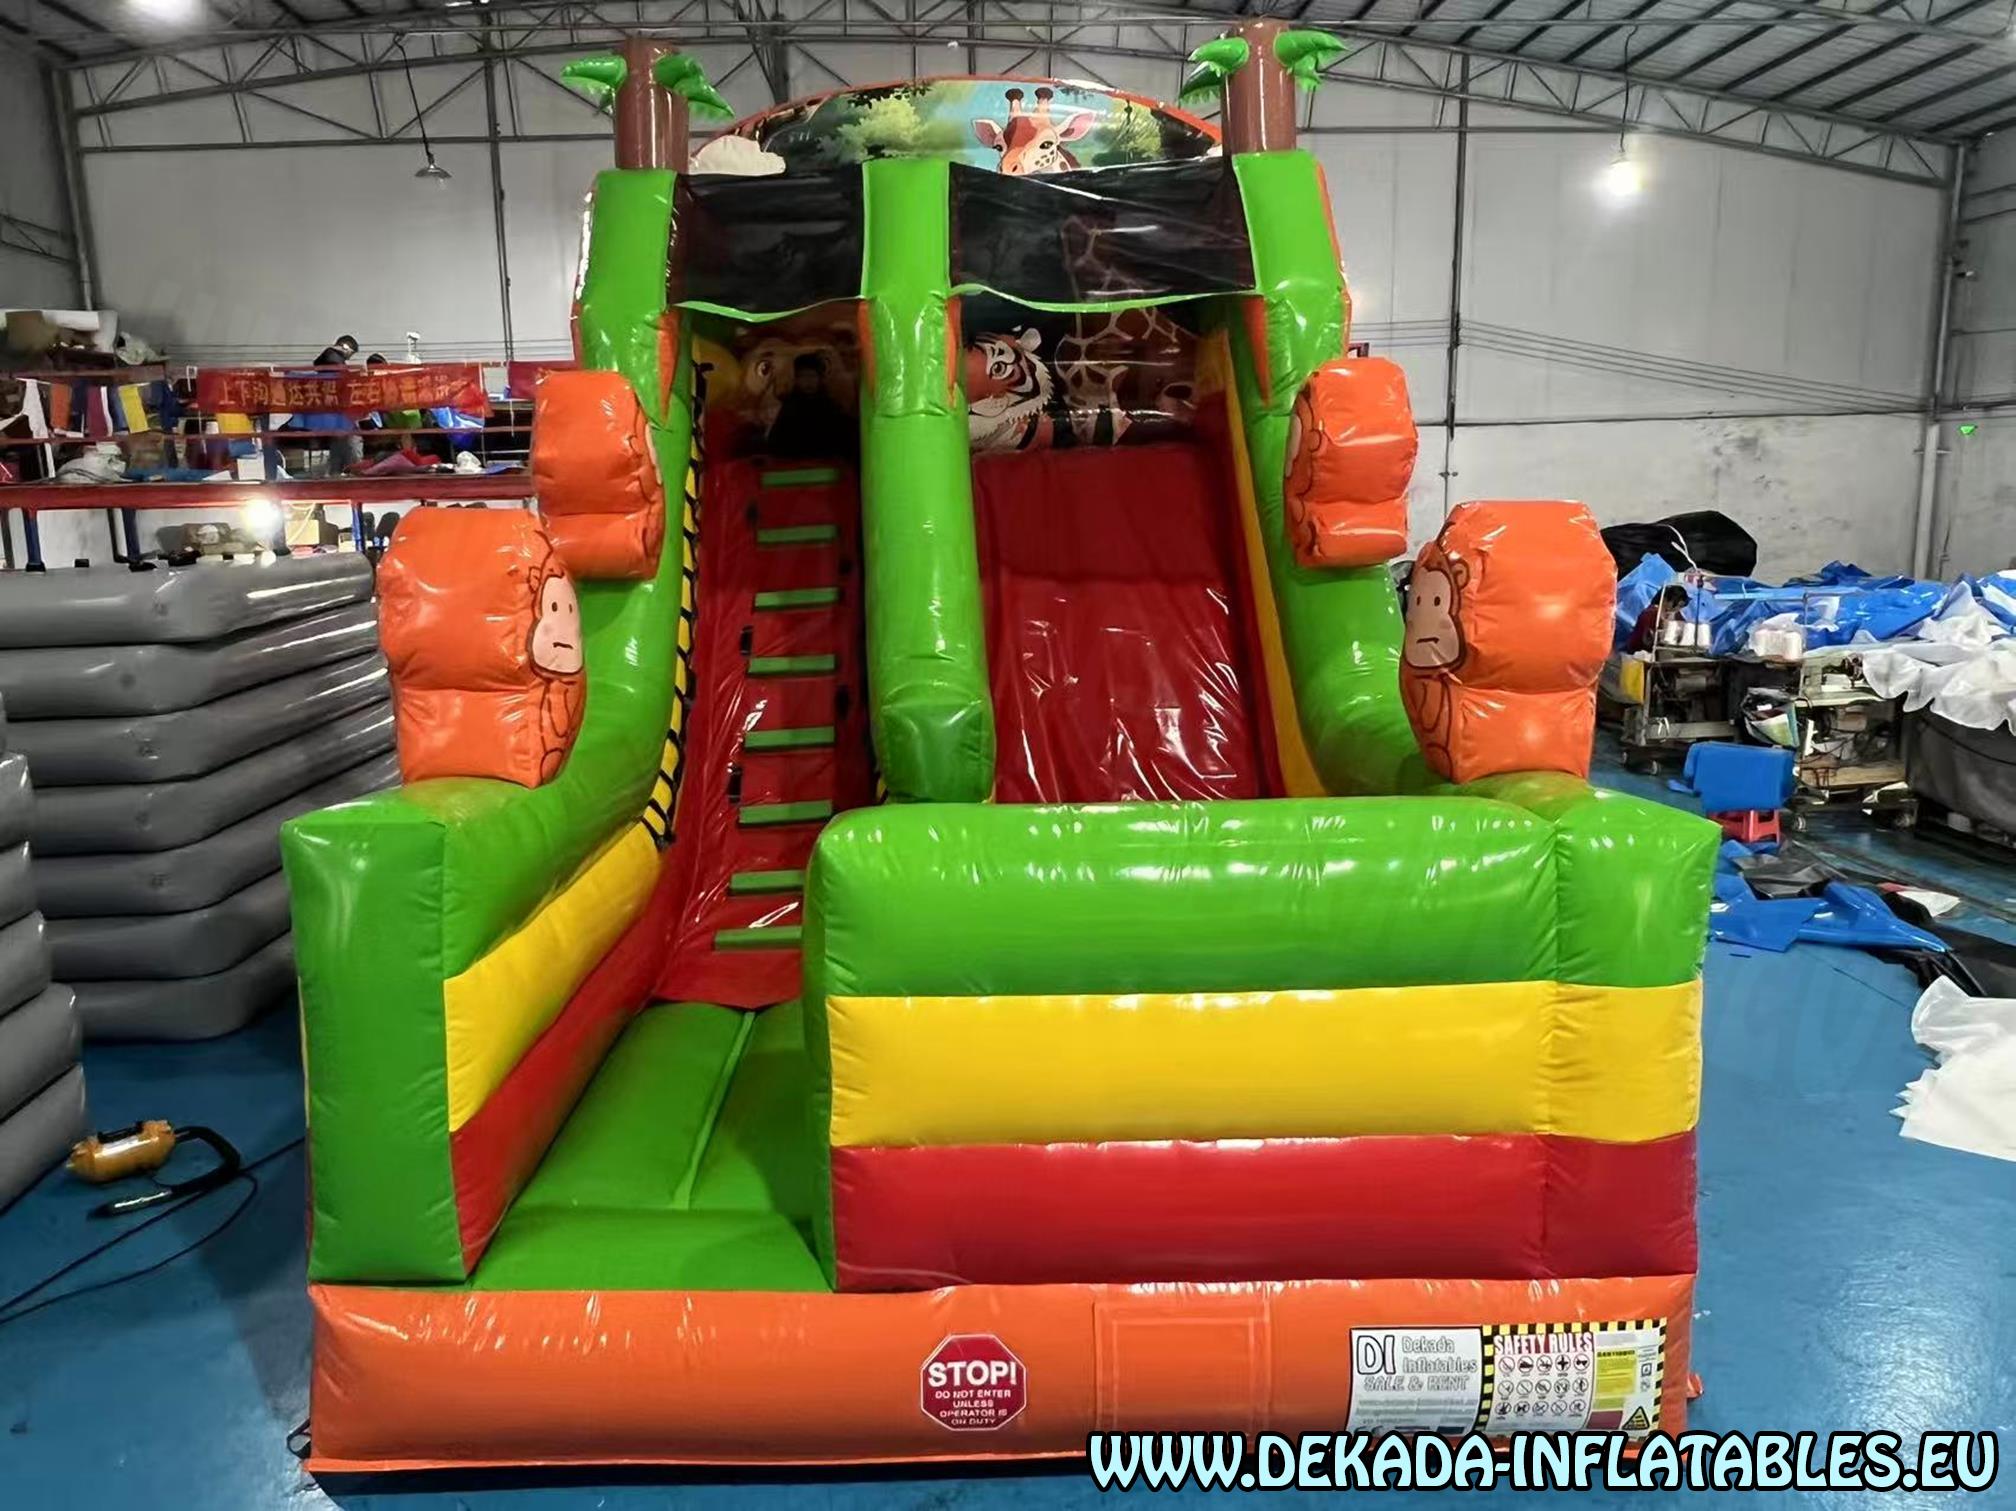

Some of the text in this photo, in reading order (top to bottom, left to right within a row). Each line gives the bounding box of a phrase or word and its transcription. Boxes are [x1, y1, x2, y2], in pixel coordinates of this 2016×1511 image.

[1402, 1336, 1454, 1353] Dekada
[1493, 1333, 1546, 1354] SAFETY
[1549, 1331, 1593, 1353] RULES
[1357, 1335, 1396, 1375] DI
[1402, 1357, 1477, 1373] Inflatables
[1364, 1375, 1470, 1391] SALE & RENT
[935, 1389, 1011, 1399] DO NOT ENTER
[952, 1400, 994, 1408] UNLESS
[940, 1409, 995, 1418] OPERATOR
